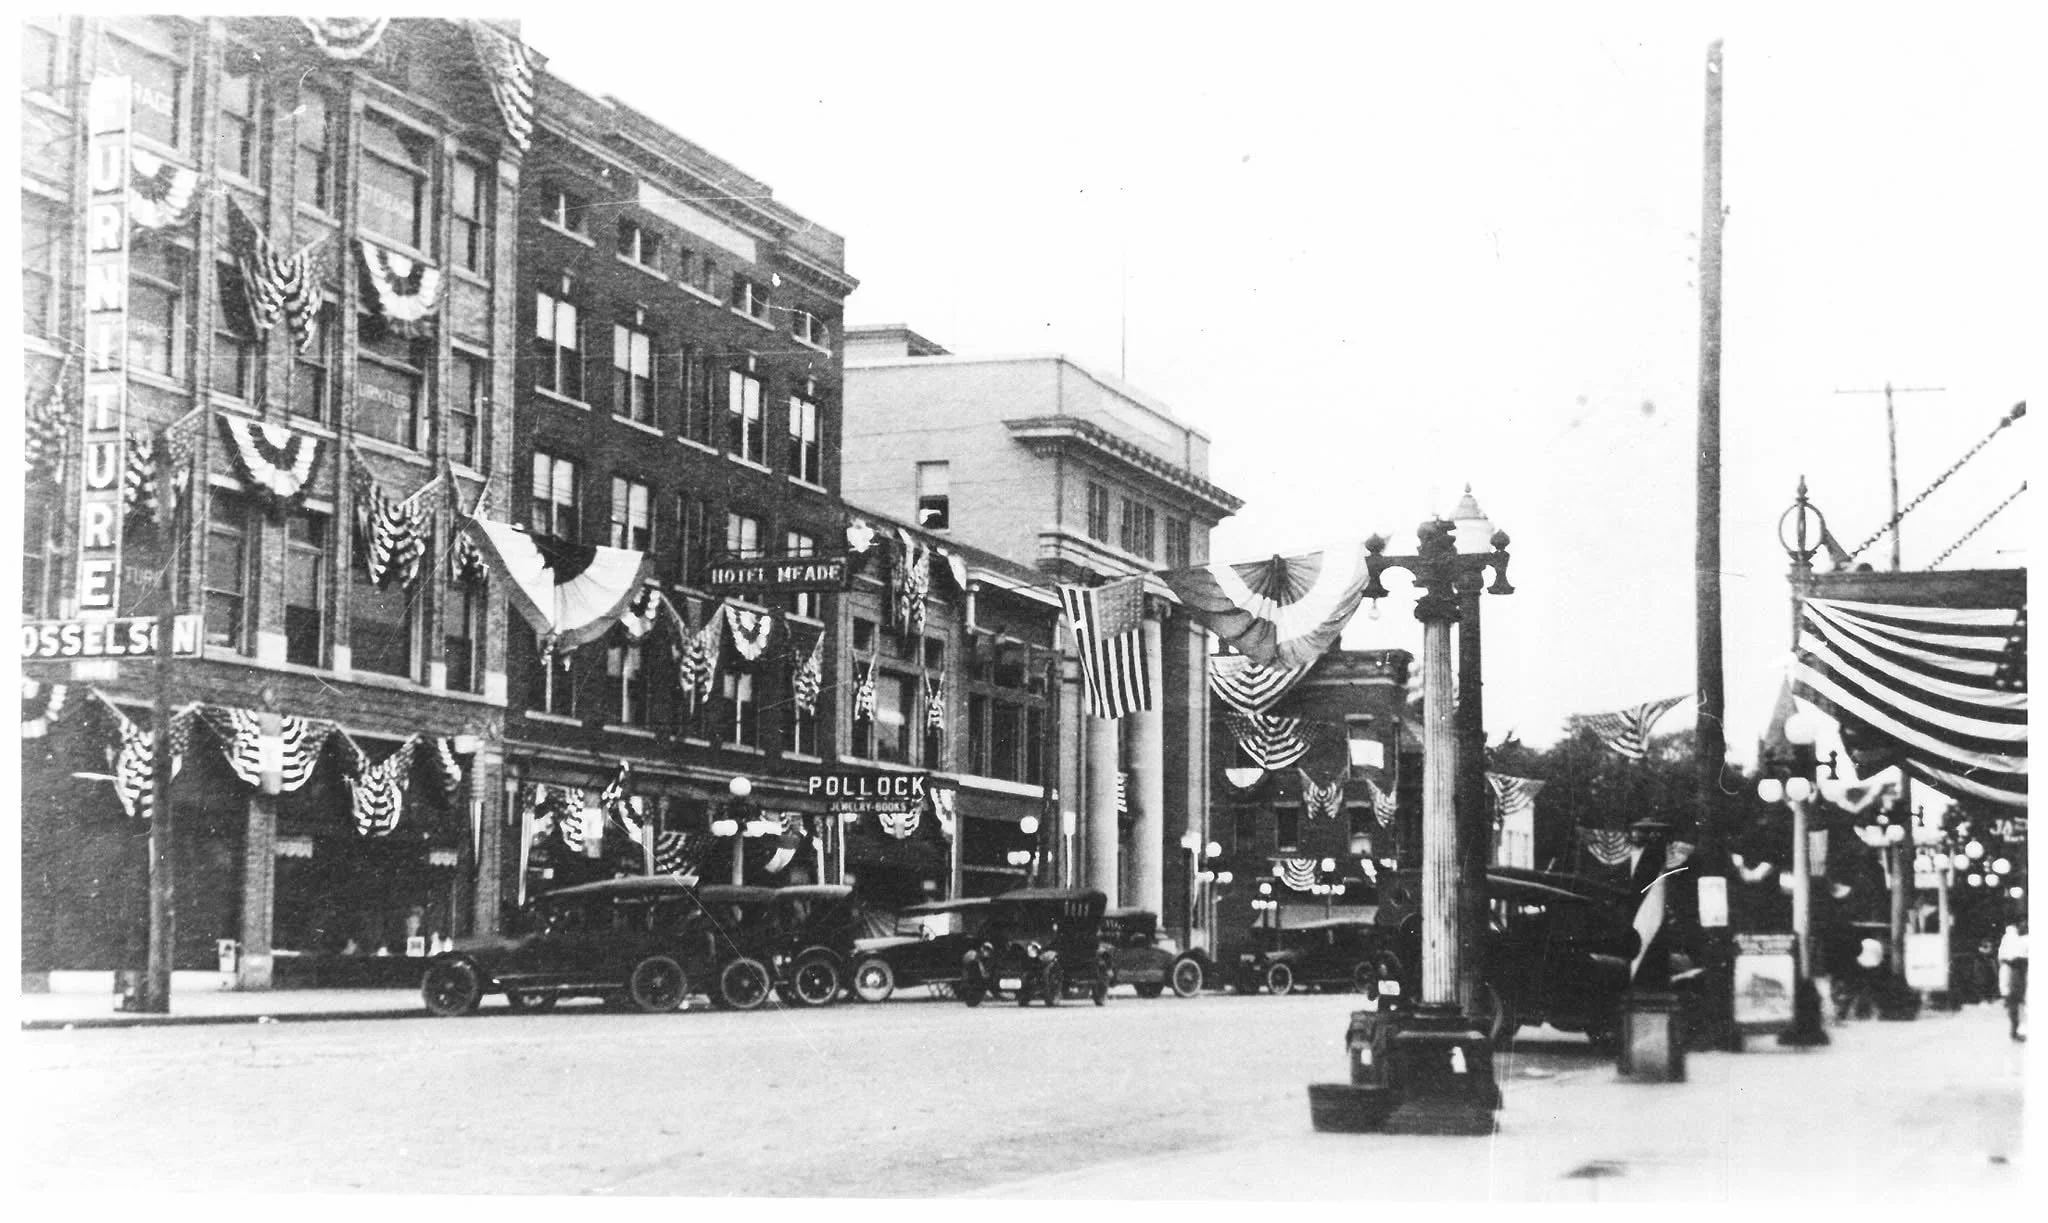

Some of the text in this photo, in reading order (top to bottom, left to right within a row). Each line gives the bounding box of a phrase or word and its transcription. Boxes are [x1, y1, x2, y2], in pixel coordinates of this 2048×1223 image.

[711, 564, 841, 585] HOTEL MEADE
[808, 775, 926, 796] POLLOCK
